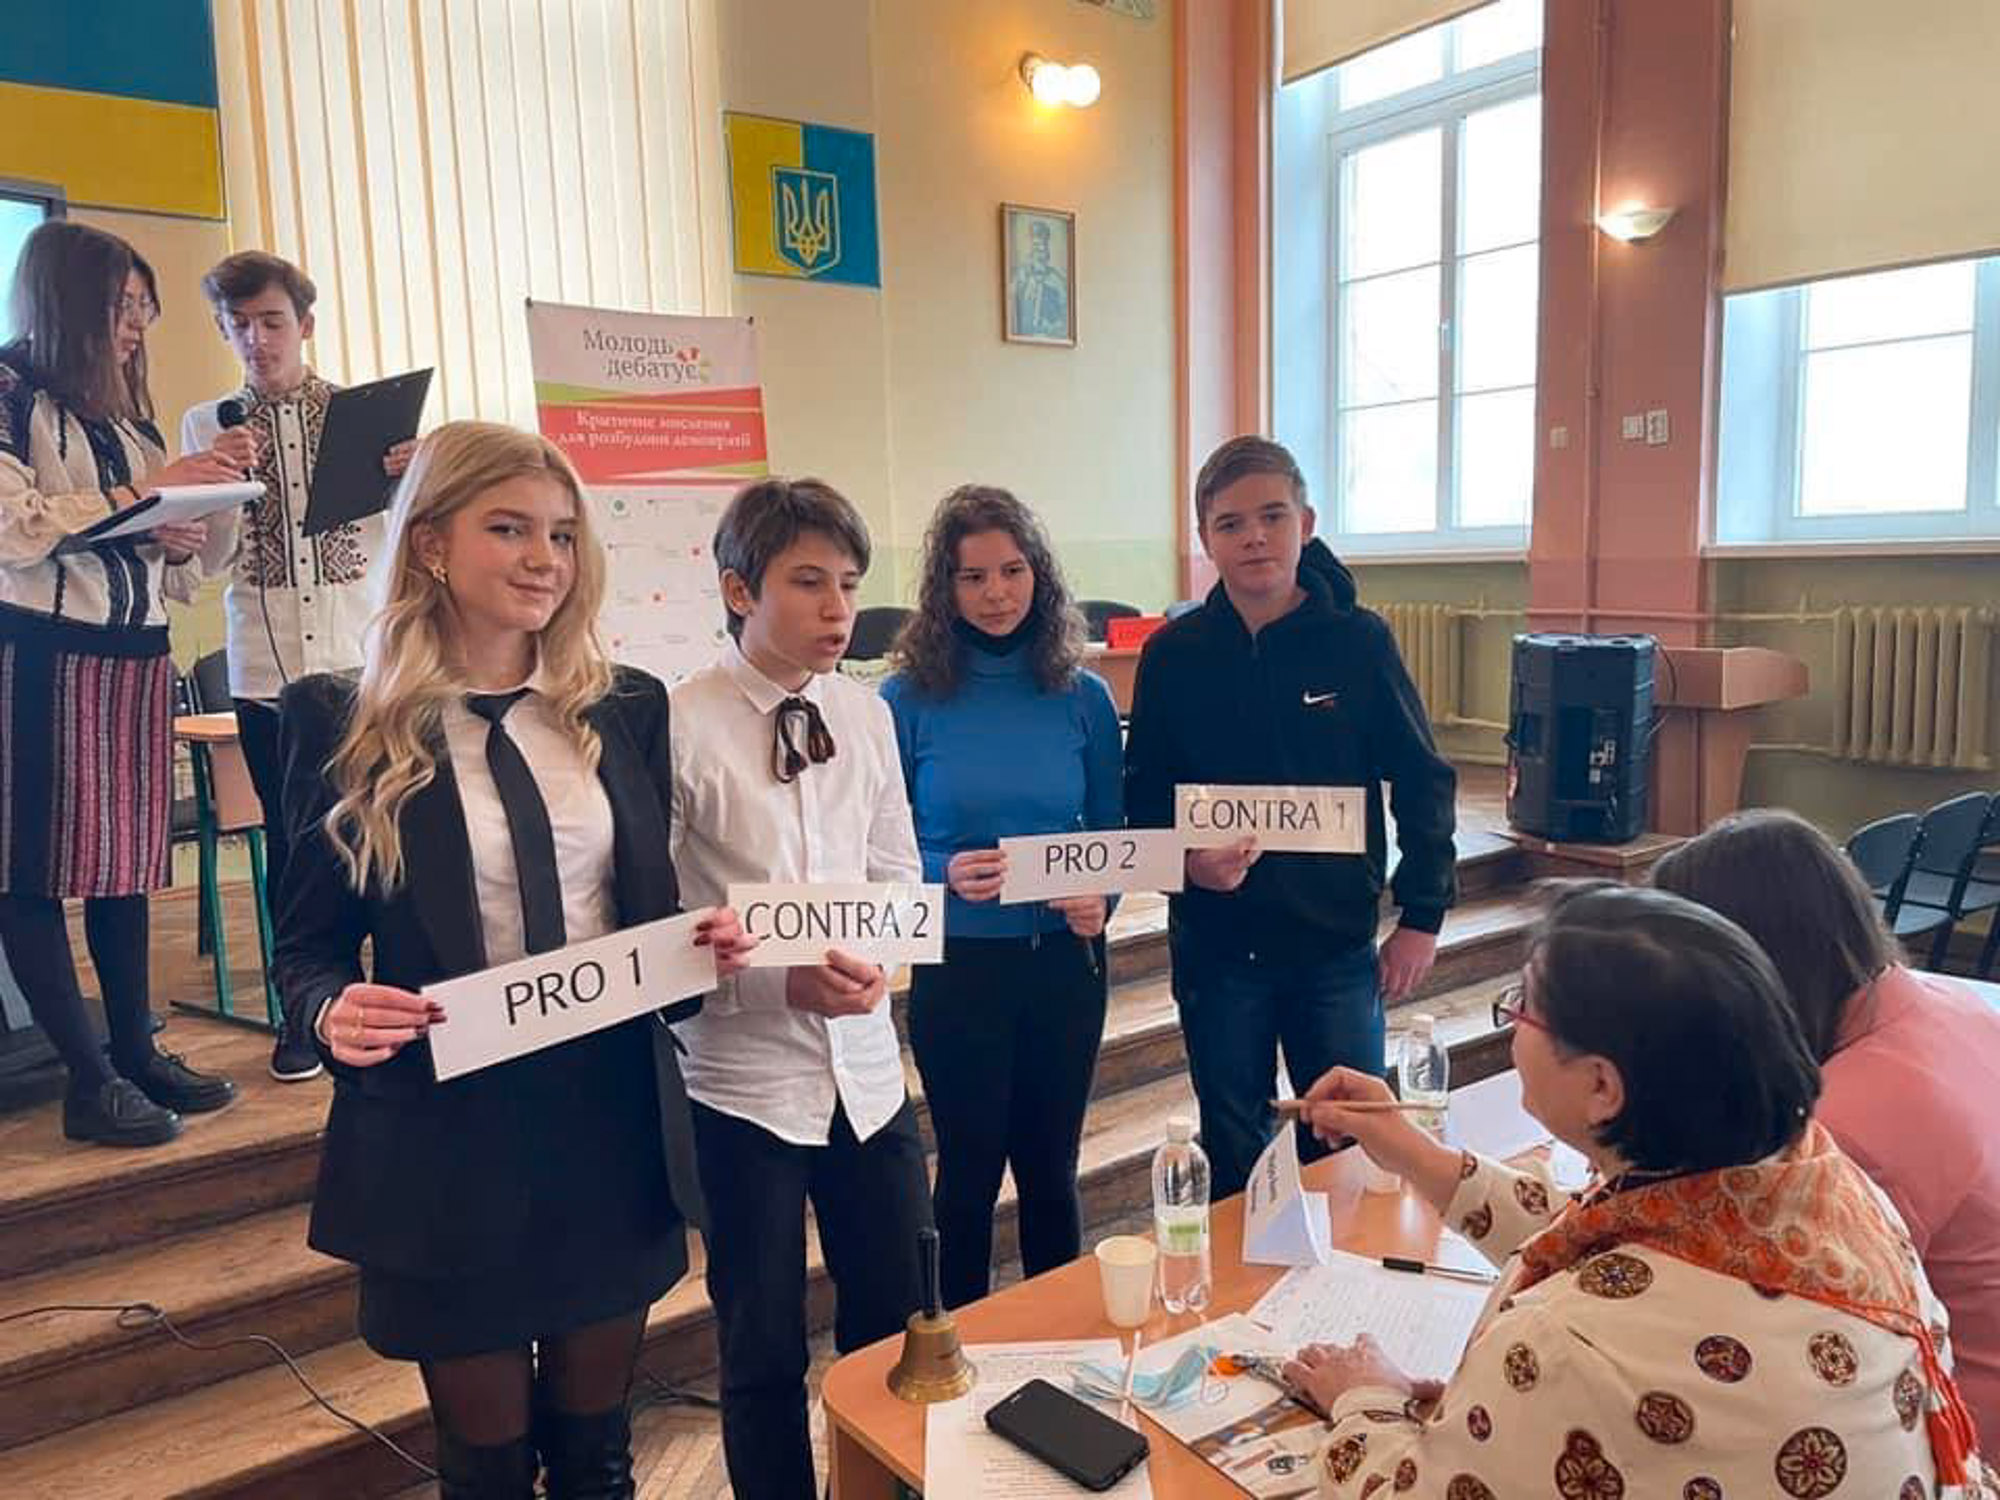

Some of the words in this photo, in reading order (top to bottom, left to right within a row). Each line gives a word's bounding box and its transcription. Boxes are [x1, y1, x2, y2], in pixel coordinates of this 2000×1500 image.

[583, 329, 674, 358] Молодь
[1188, 799, 1321, 831] CONTRA
[1336, 802, 1346, 830] 1
[1044, 843, 1109, 875] PRO
[1120, 841, 1138, 870] 2
[745, 901, 901, 942] CONTRA
[912, 902, 929, 939] 2
[504, 961, 606, 1026] PRO
[626, 947, 643, 988] 1
